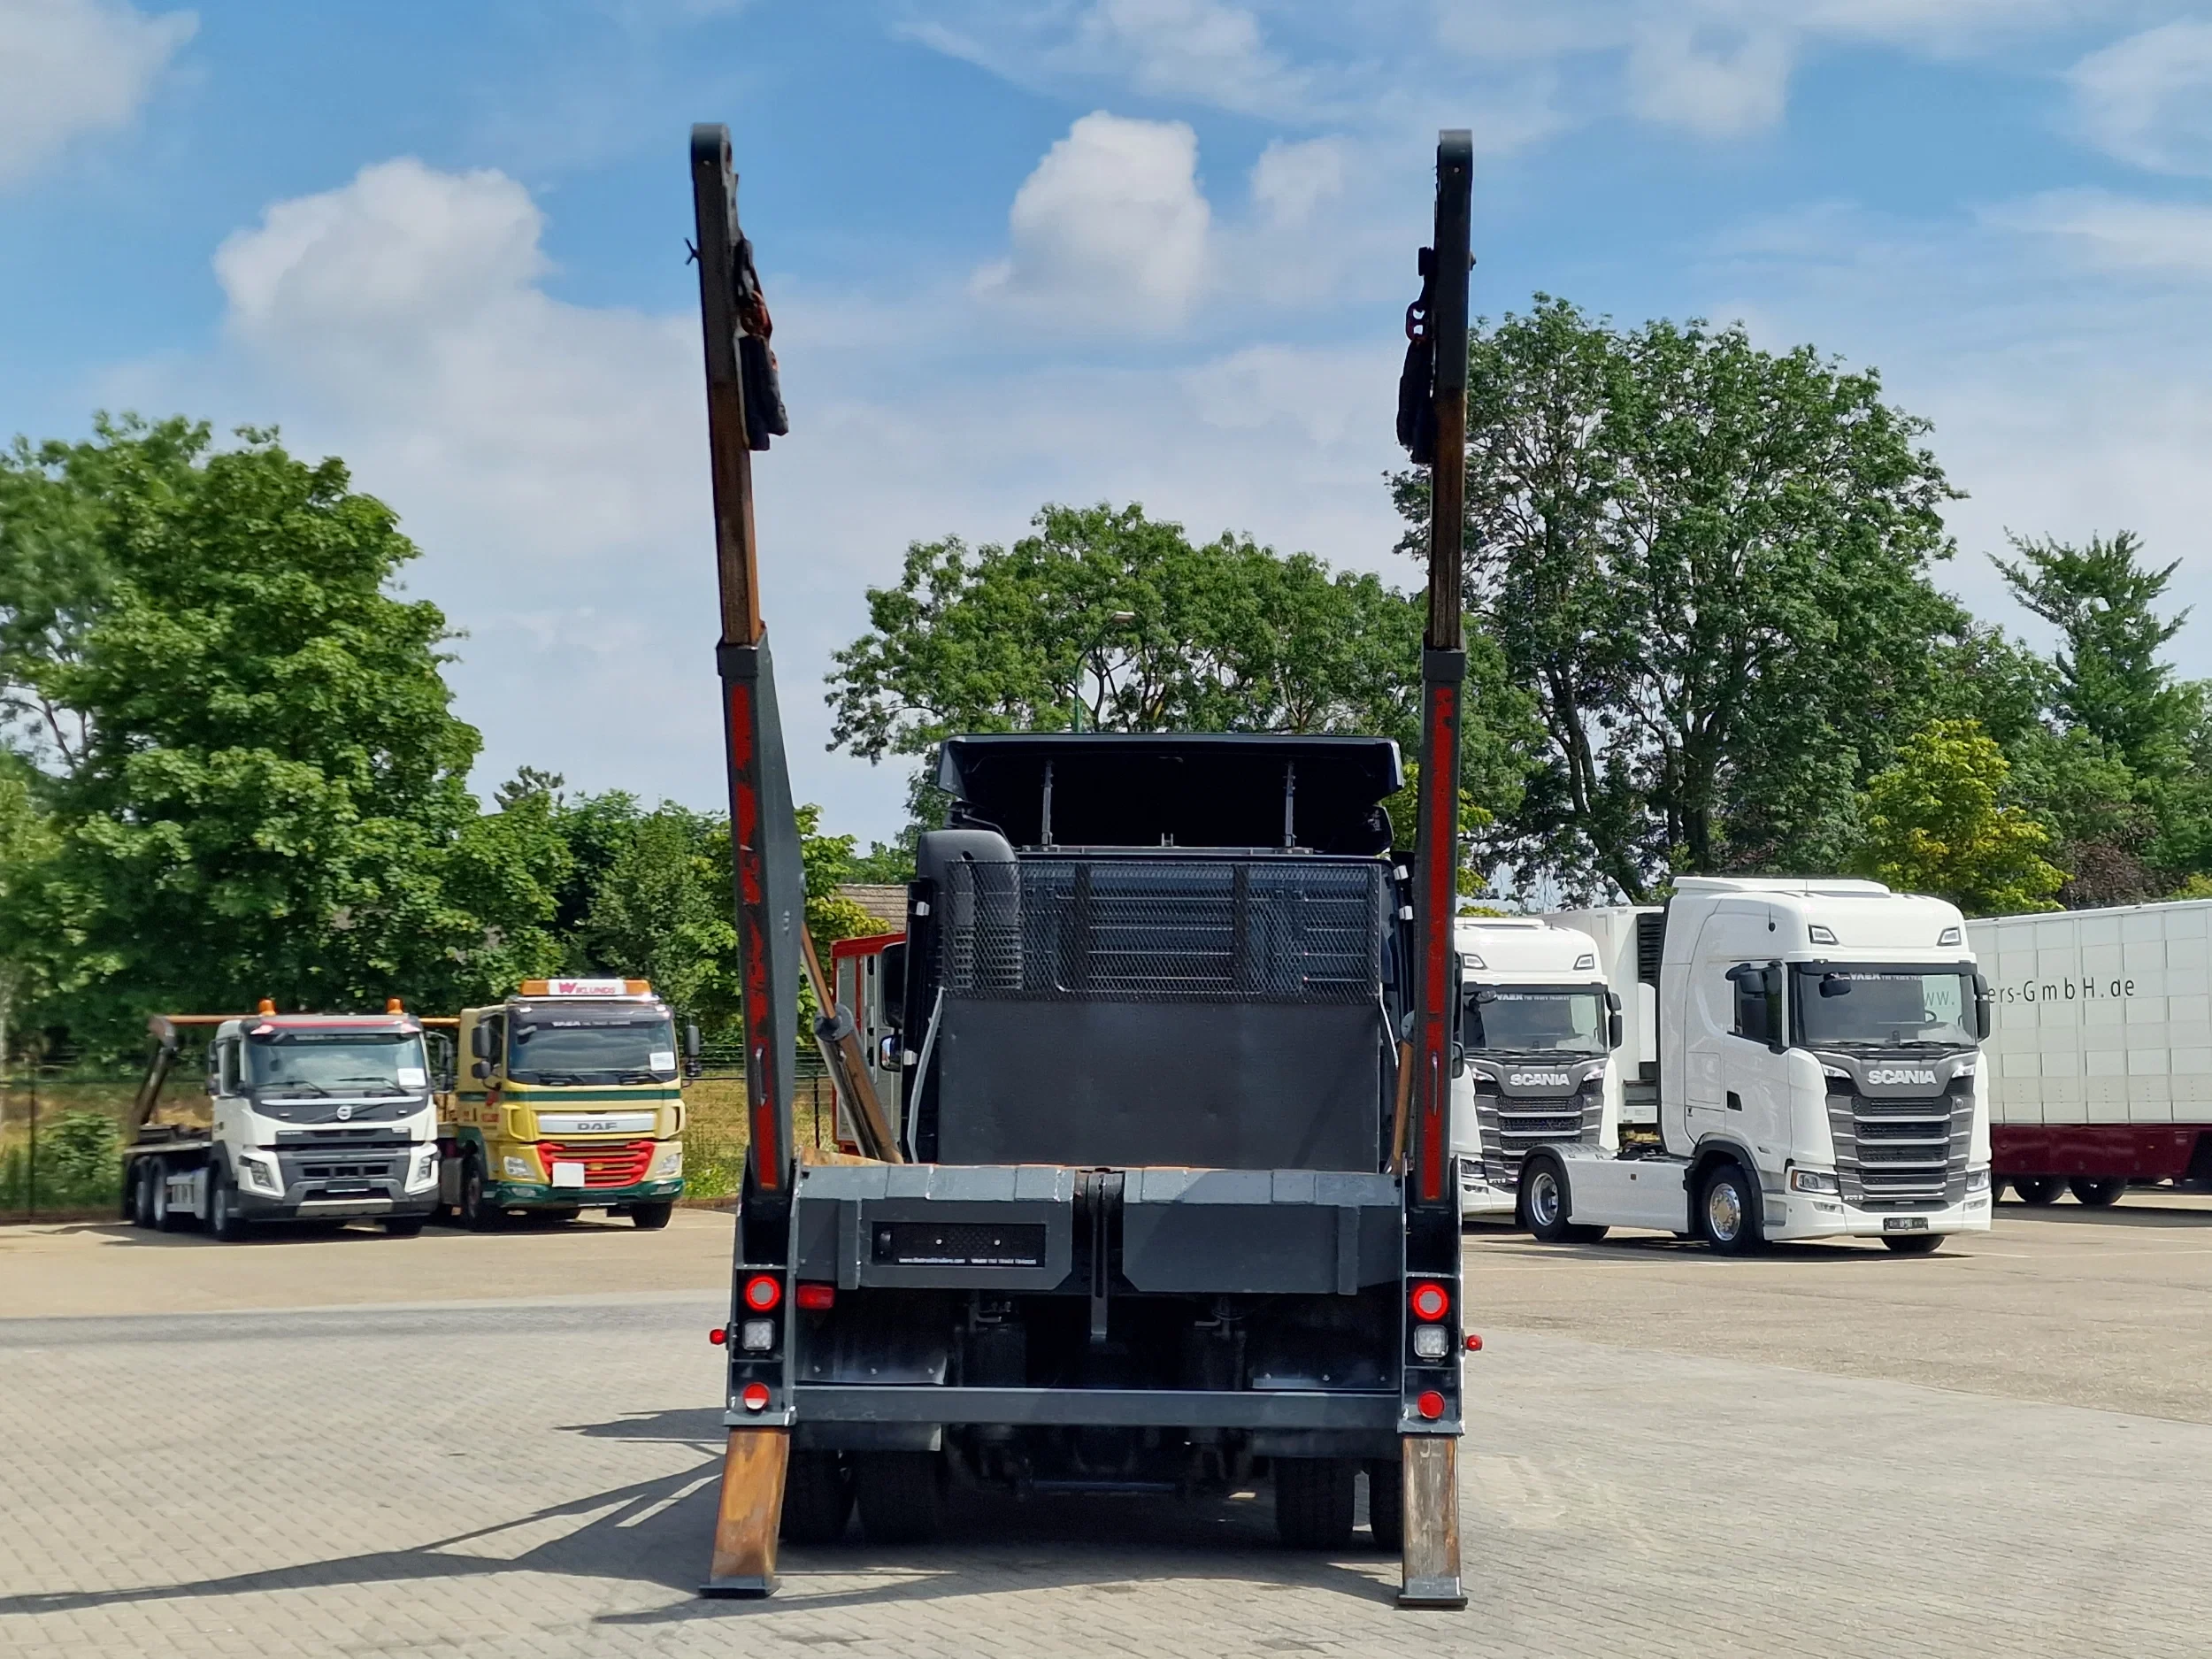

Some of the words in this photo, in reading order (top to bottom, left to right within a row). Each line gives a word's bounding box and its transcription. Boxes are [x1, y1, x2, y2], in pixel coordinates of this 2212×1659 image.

[1987, 978, 2135, 1003] ers-GmbH.de
[1509, 1073, 1571, 1086] SCANIA
[1867, 1069, 1938, 1084] SCANIA
[577, 1122, 618, 1131] DAF
